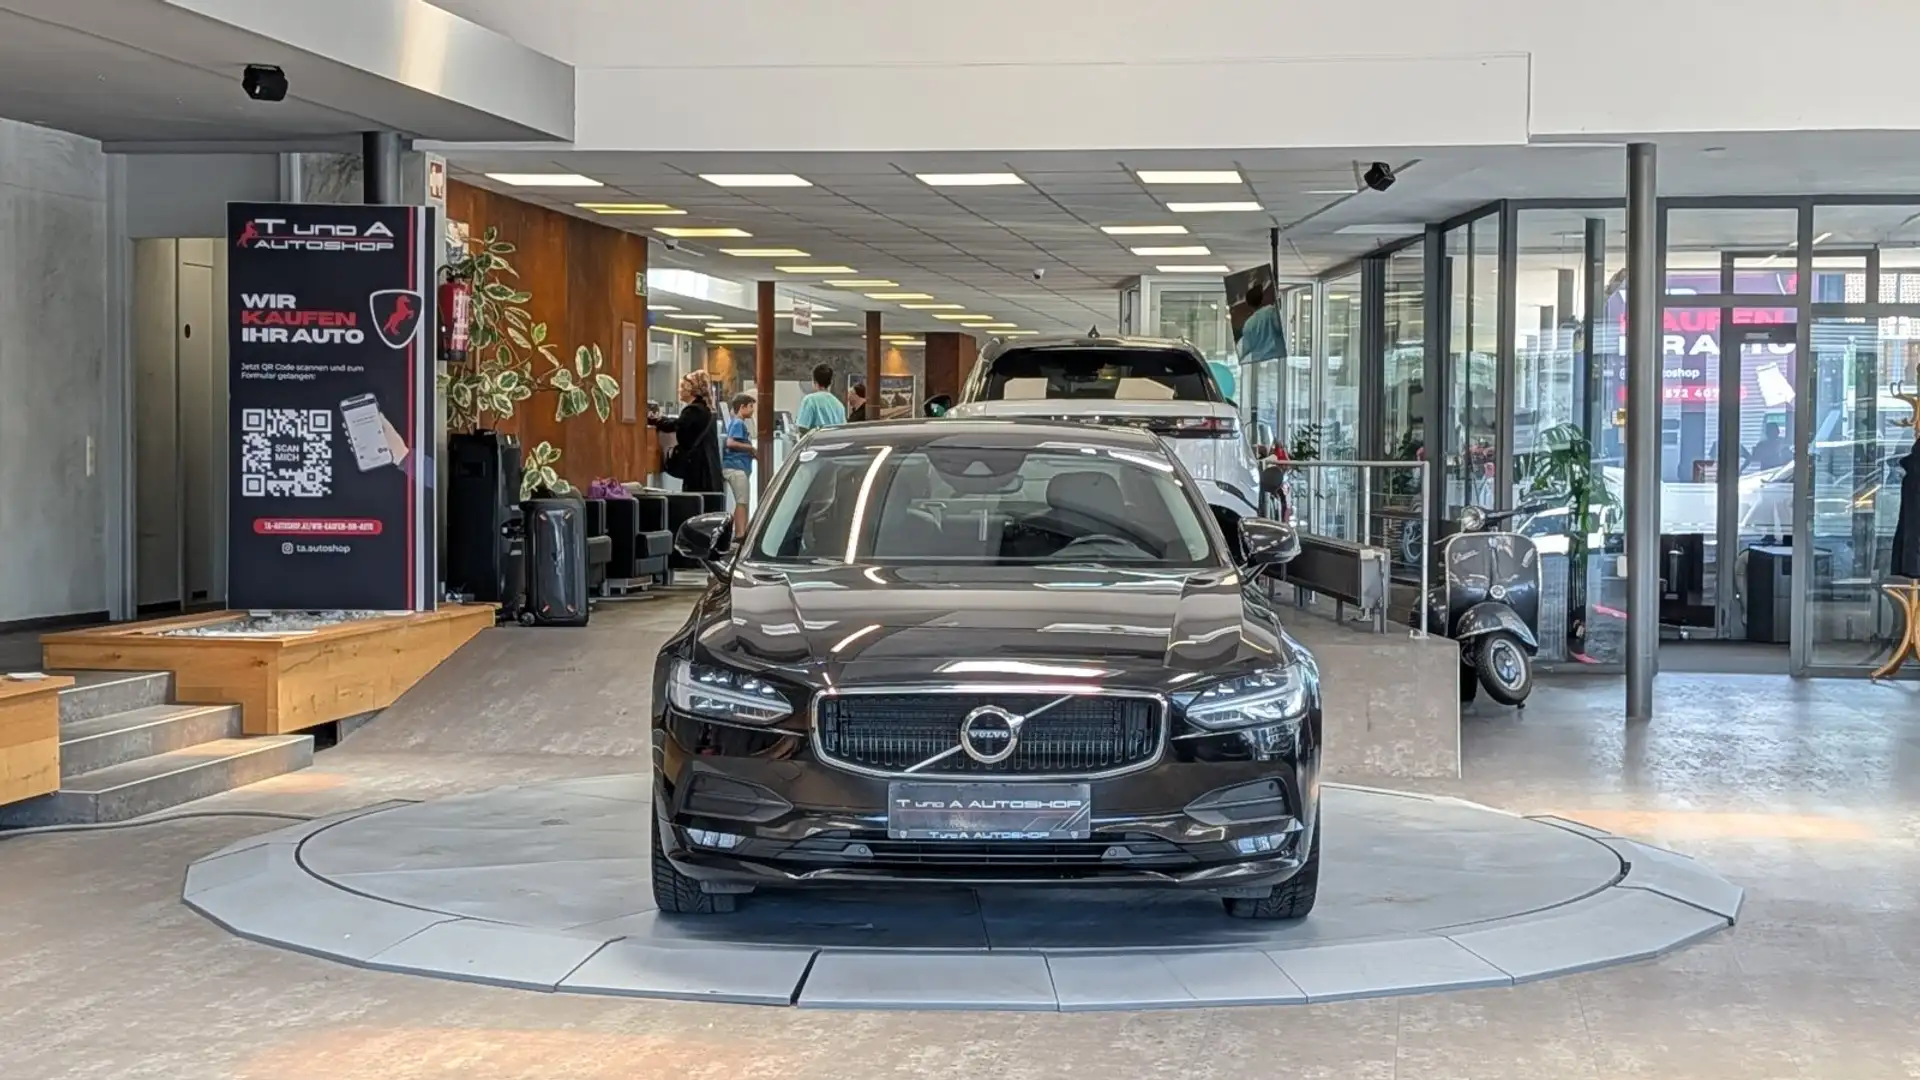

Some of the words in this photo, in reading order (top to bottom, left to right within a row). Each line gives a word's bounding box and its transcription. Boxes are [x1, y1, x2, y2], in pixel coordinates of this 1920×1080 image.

[254, 218, 287, 234] T
[363, 221, 395, 237] A
[254, 239, 395, 252] AUTOSHOP
[241, 293, 297, 310] WIR
[241, 310, 357, 326] KAUFEN
[241, 327, 288, 343] IHR
[291, 328, 365, 344] AUTO
[241, 362, 260, 371] Jetzt
[261, 363, 274, 372] QR
[275, 363, 295, 371] Code
[296, 364, 329, 372] scannen
[330, 364, 346, 372] und
[347, 365, 365, 373] zum
[241, 371, 277, 380] Formular
[275, 444, 300, 452] SCAN
[275, 453, 300, 461] MICH
[296, 543, 351, 555] ta.autoshop
[968, 730, 1010, 739] VOLVO
[896, 799, 911, 808] T
[949, 799, 964, 809] A
[968, 799, 1082, 809] AUTOSHOP
[973, 831, 1050, 839] AUTOSHOP
